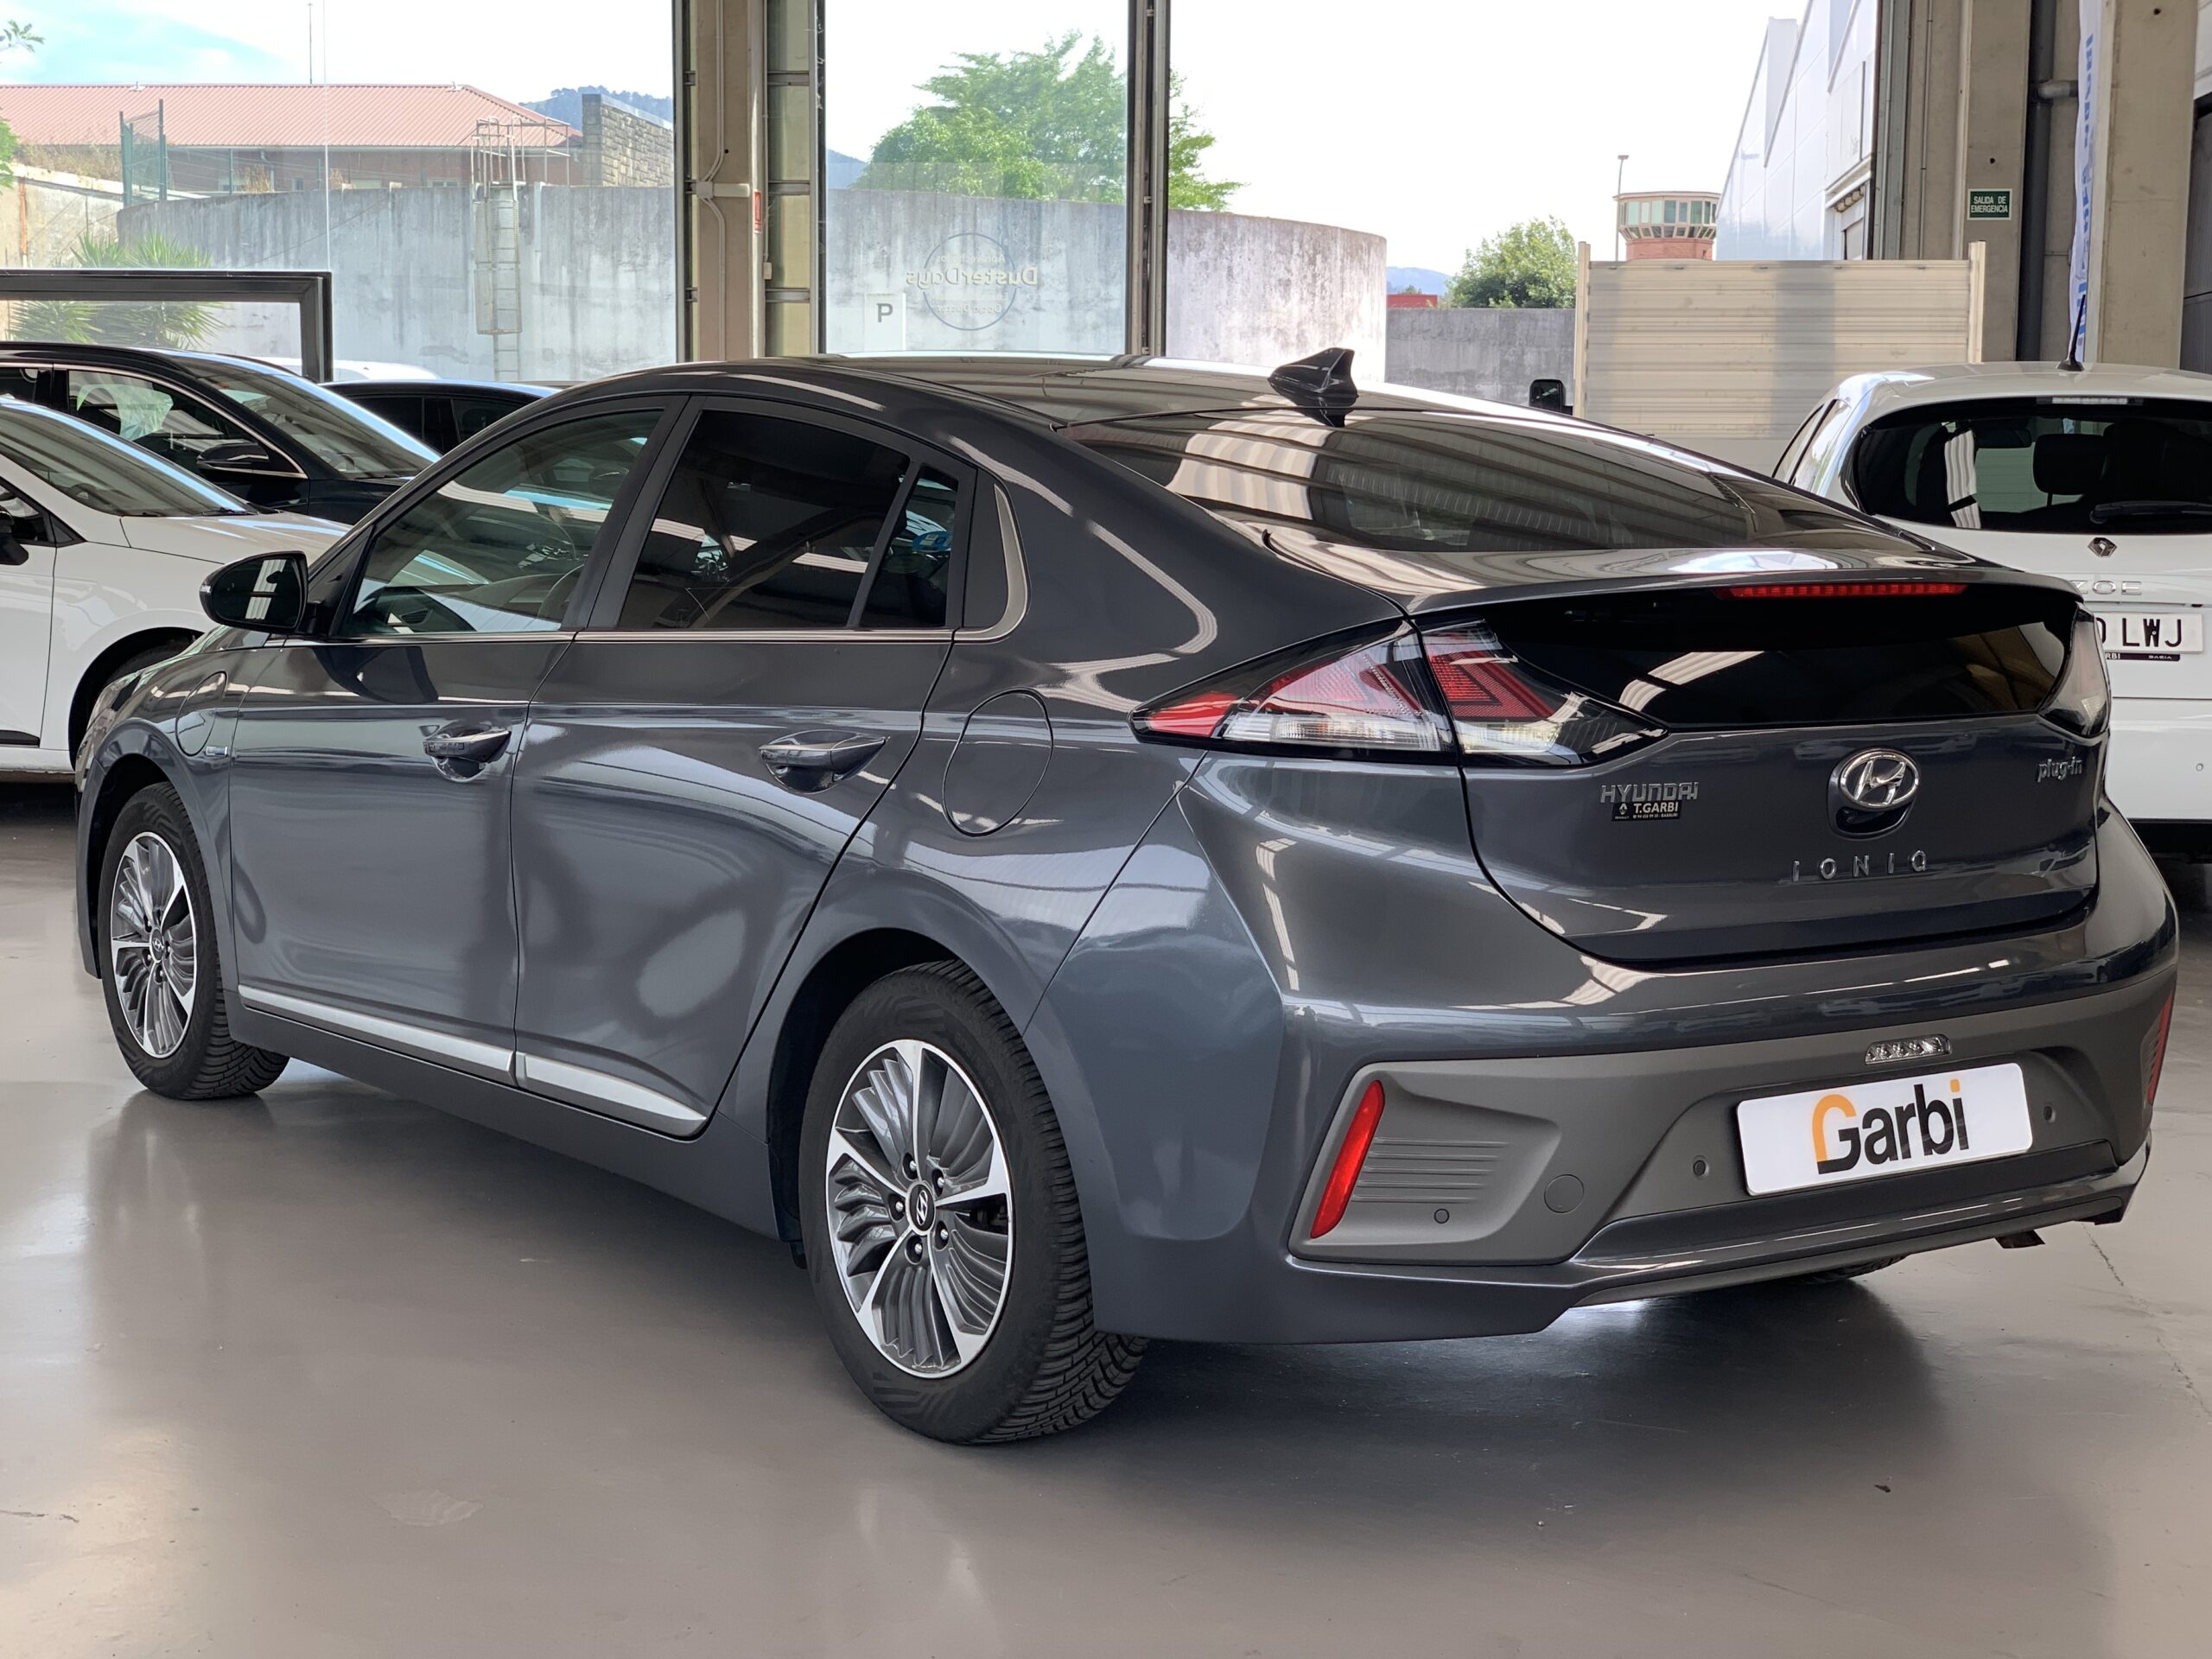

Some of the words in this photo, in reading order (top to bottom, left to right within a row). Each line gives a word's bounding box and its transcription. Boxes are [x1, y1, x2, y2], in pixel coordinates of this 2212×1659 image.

[876, 303, 893, 322] P
[2122, 618, 2182, 647] LWJ
[1600, 782, 1699, 803] HYUNDAI
[1633, 802, 1679, 814] T.GARBI
[1792, 850, 1927, 883] IONIQ
[1812, 1078, 1969, 1175] Garbi
